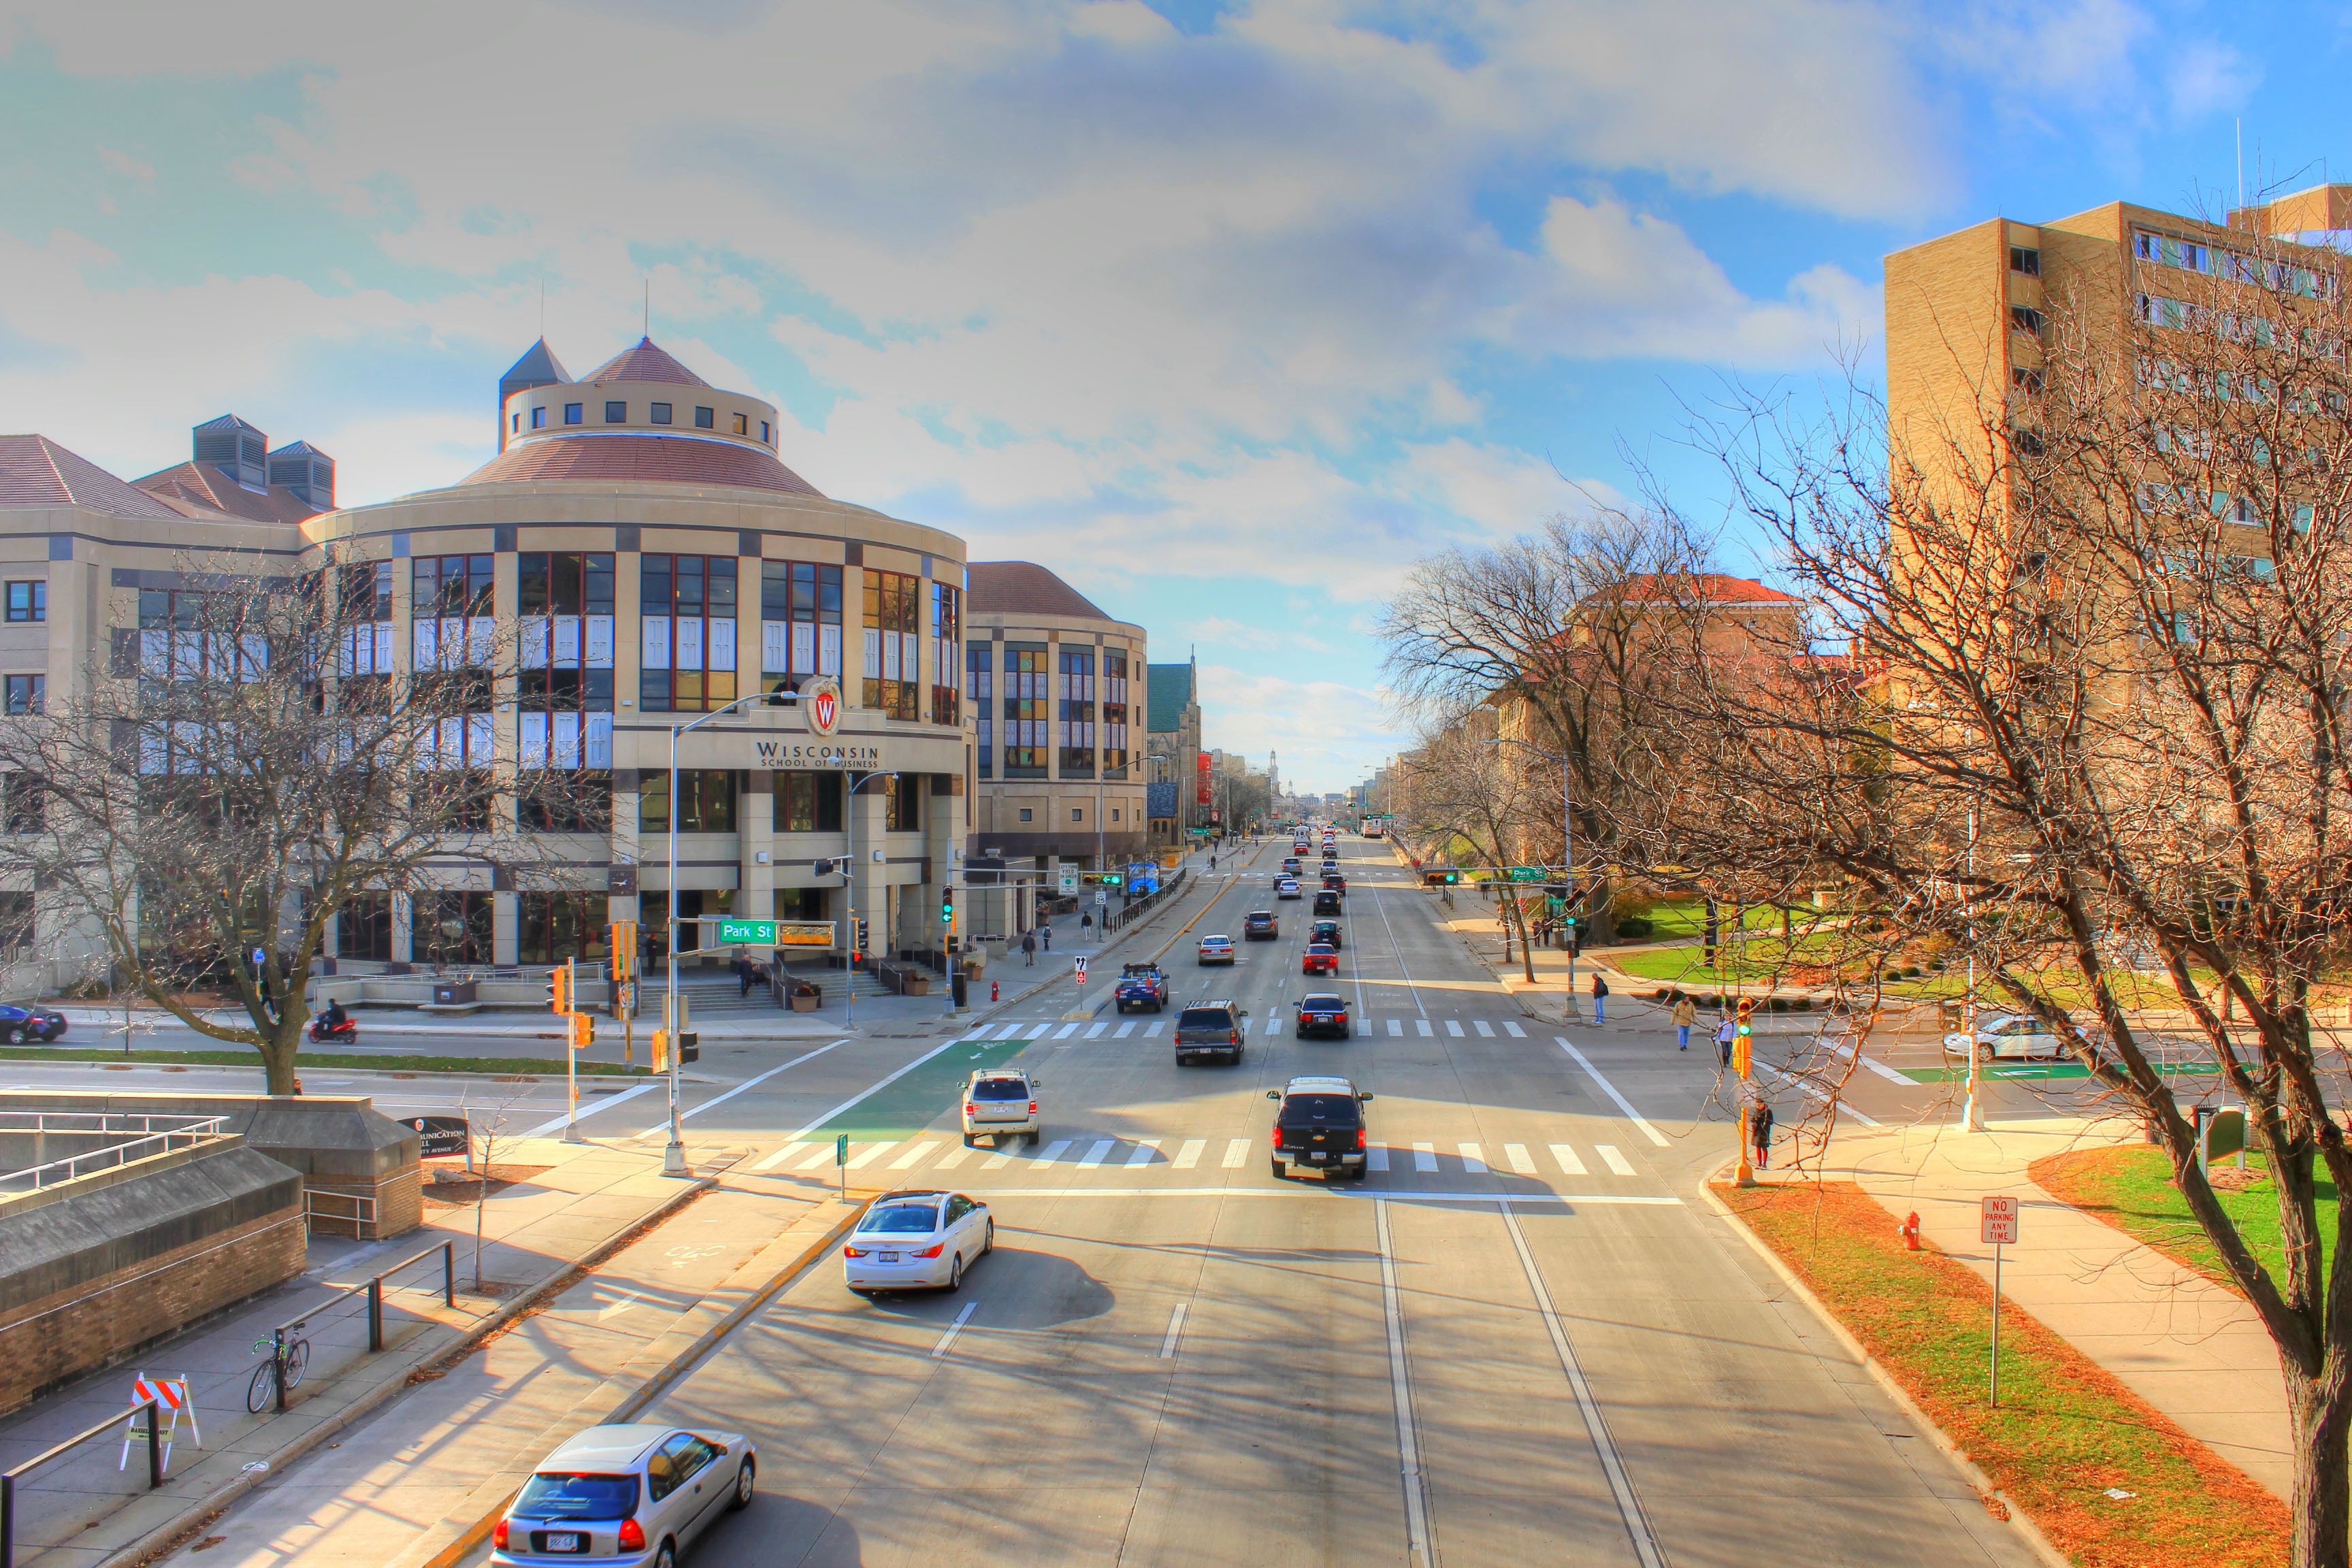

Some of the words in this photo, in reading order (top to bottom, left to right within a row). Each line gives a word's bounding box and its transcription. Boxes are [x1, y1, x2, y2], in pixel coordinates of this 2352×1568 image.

[817, 699, 834, 725] W
[762, 759, 807, 767] SCHOOL
[723, 925, 750, 937] Park
[757, 926, 771, 938] St
[1993, 1200, 2007, 1211] NO
[1985, 1213, 2014, 1222] PARKING
[1990, 1232, 2008, 1240] TIME
